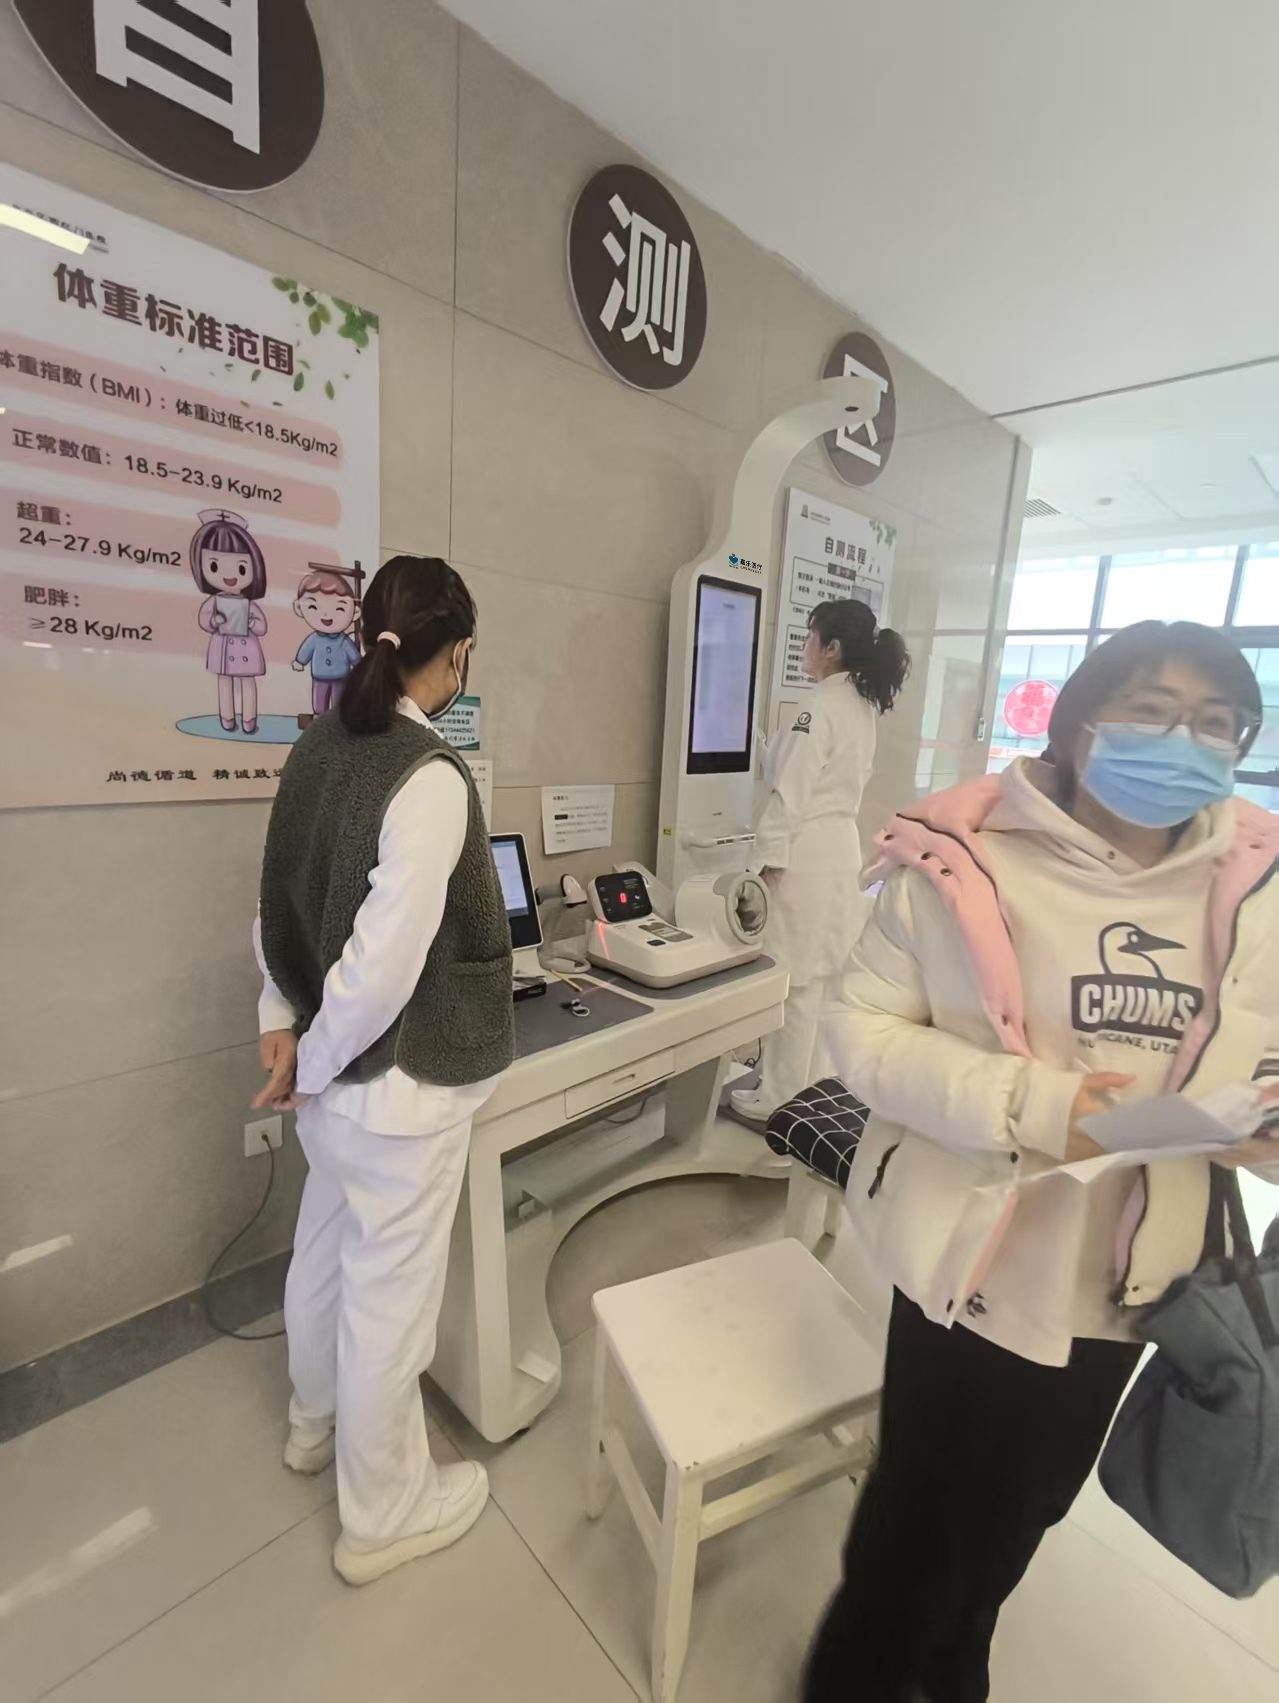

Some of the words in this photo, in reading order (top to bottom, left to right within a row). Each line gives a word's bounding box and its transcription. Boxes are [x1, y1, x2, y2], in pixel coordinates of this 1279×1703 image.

[600, 193, 691, 366] 测
[53, 263, 293, 376] 体重标准范围
[124, 455, 222, 489] 18.5-23.9
[228, 477, 282, 503] Kg/m2
[19, 527, 111, 555] 24-27.9
[117, 543, 182, 566] Kg/m2
[825, 536, 867, 565] 自测流程
[85, 620, 153, 640] Kg/m2
[1079, 983, 1196, 1032] CHUMS
